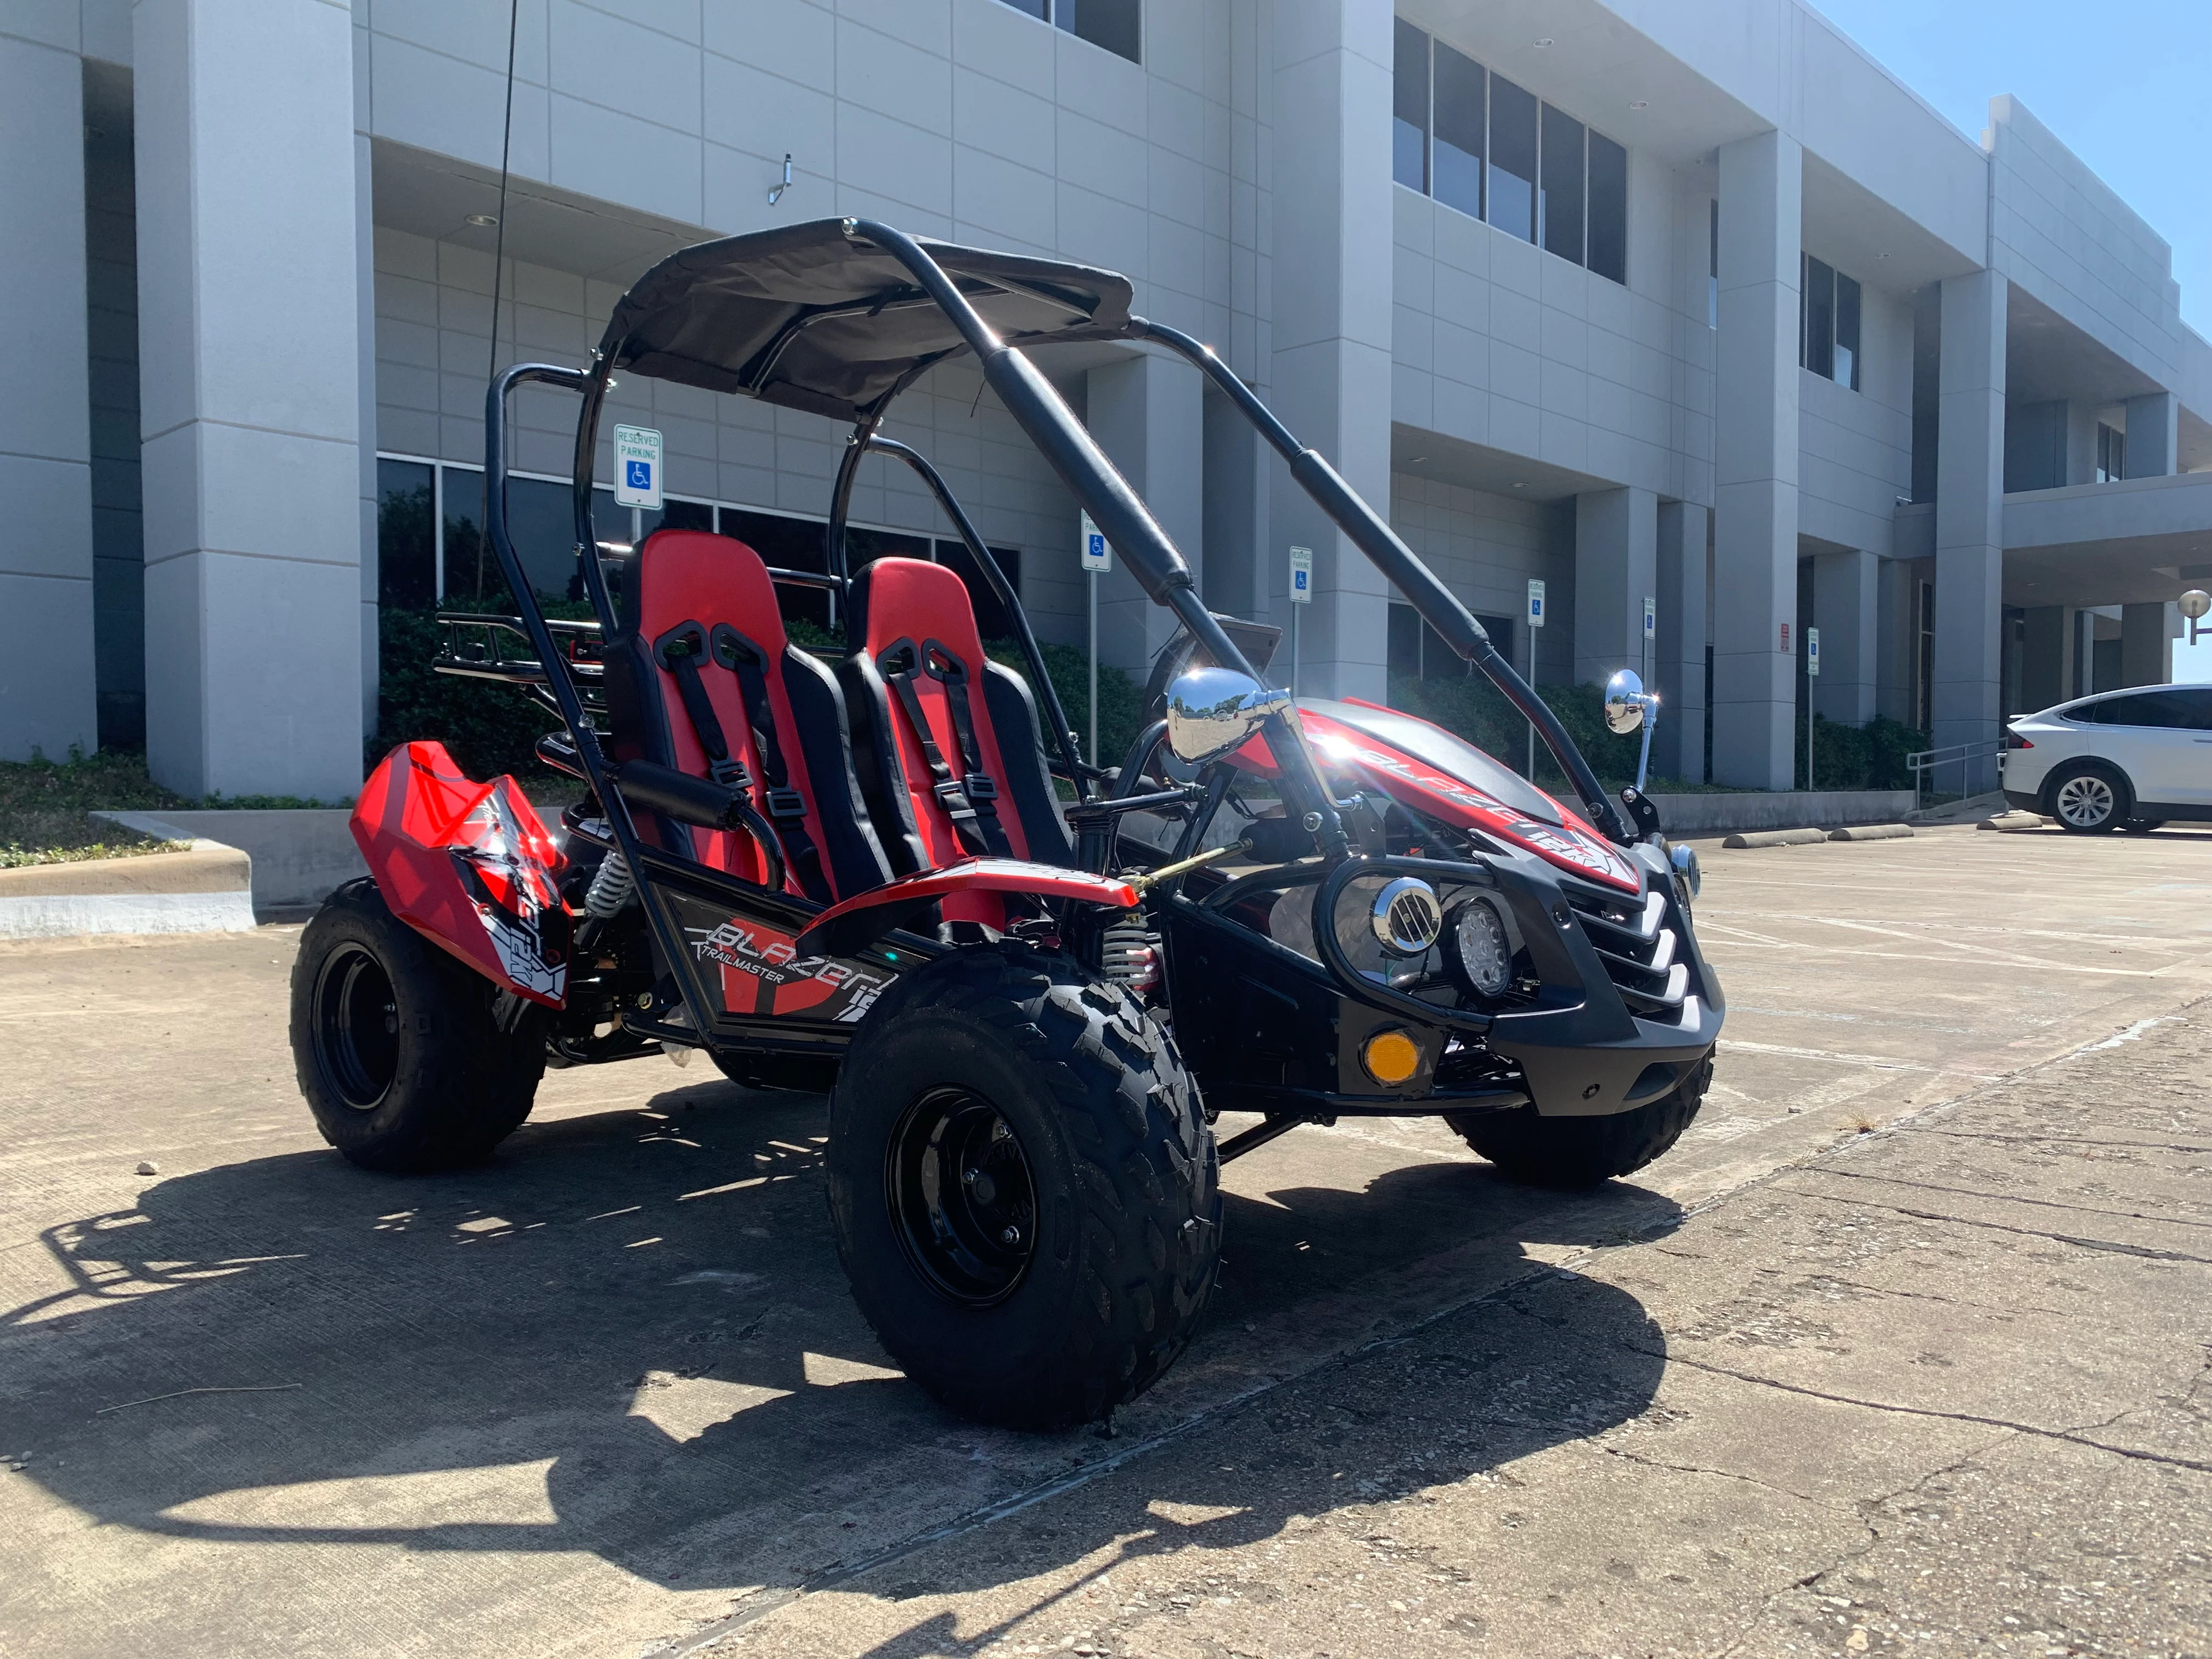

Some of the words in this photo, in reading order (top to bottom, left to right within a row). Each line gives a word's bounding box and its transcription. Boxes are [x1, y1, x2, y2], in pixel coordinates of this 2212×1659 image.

[618, 431, 658, 447] RESERVED
[621, 445, 656, 460] PARKING
[701, 945, 785, 984] TRAILMASTER
